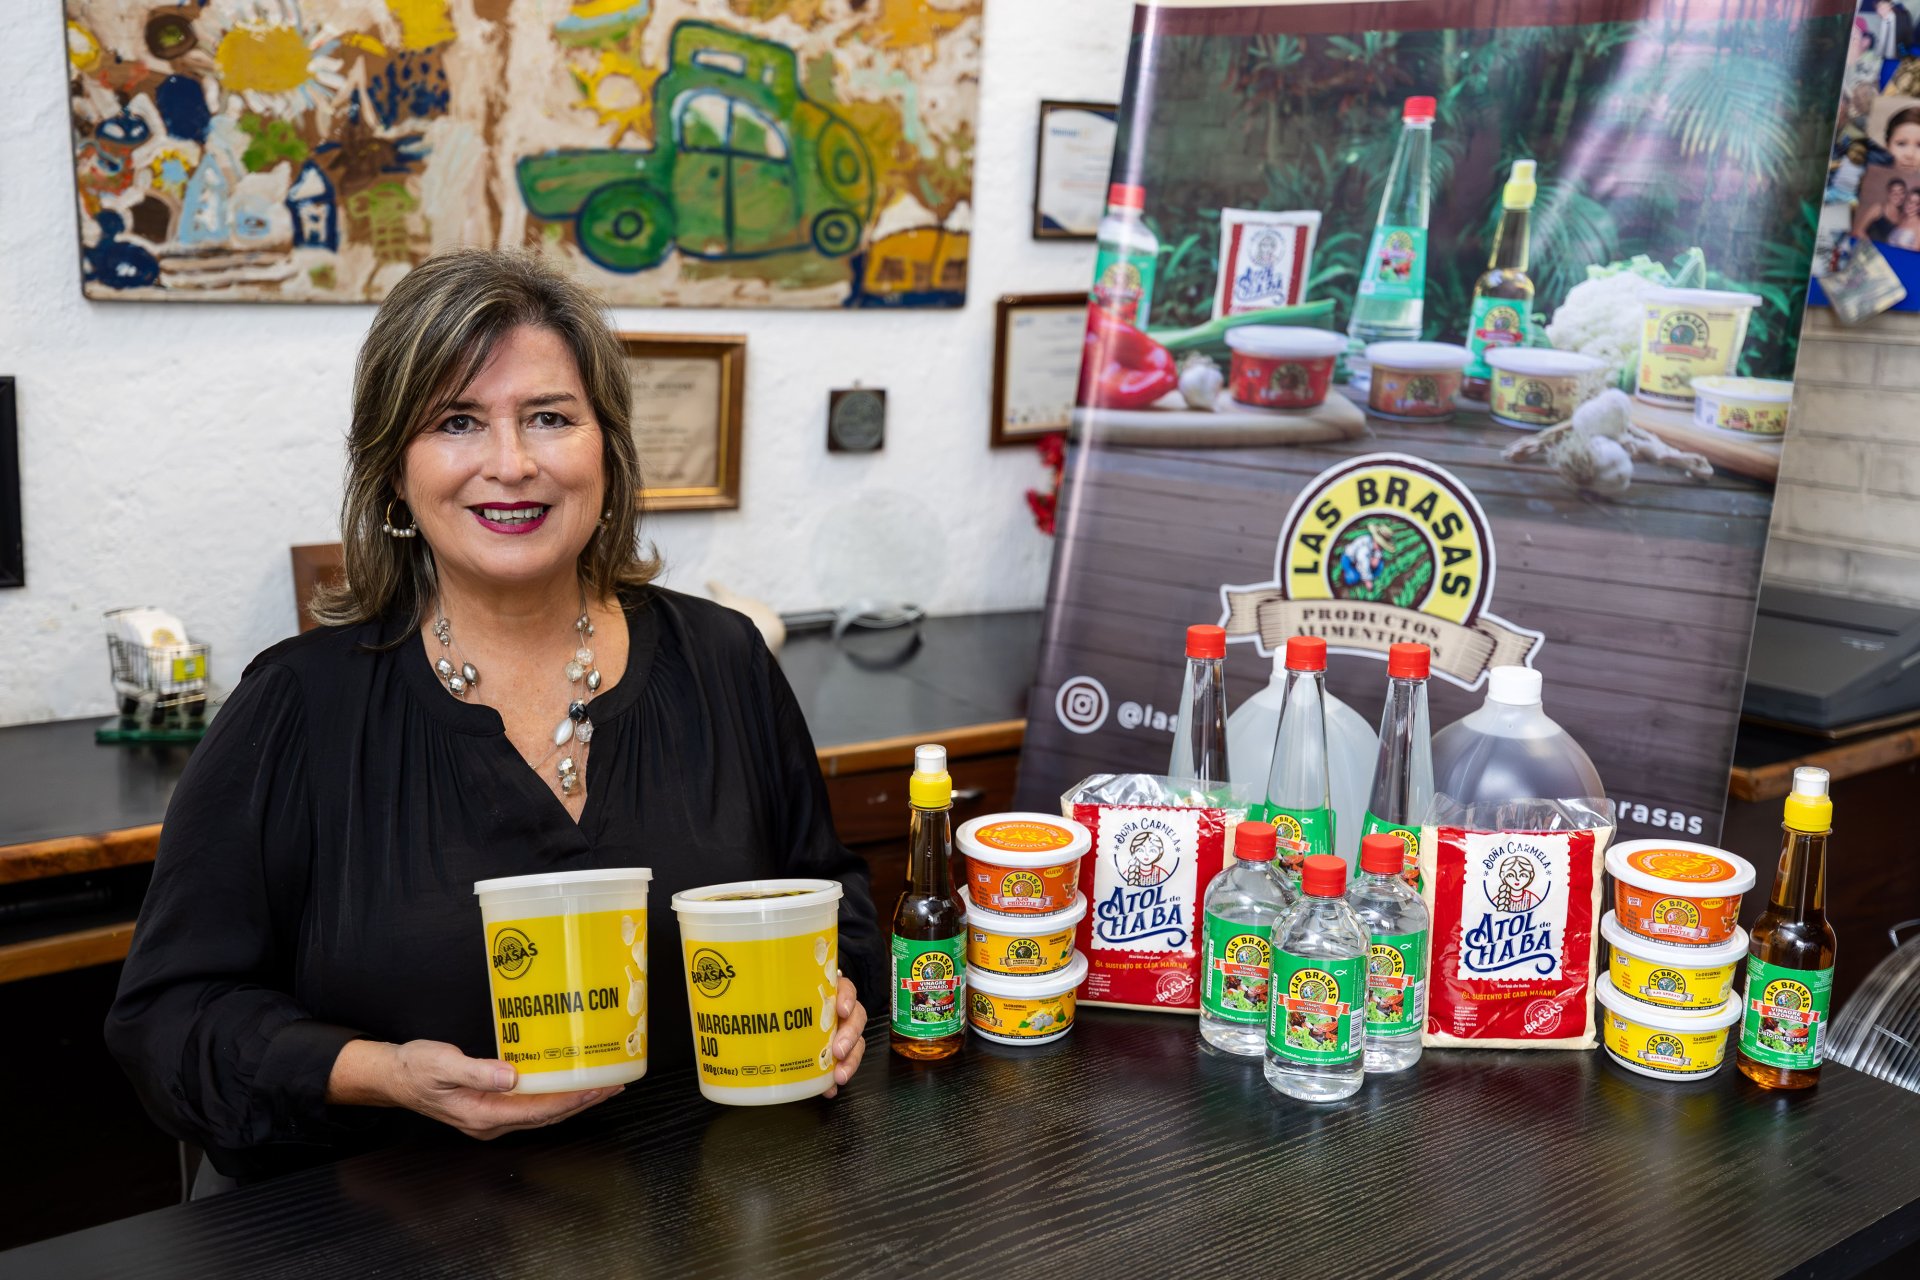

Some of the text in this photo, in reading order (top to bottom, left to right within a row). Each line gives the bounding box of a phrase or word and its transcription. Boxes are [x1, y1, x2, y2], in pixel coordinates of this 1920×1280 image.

[1294, 476, 1472, 598] LAS BRASAS
[1302, 608, 1442, 639] PRODUCTOS
[977, 829, 1069, 845] BRASAS
[1114, 818, 1181, 846] DOÑA CARMELA
[1280, 816, 1300, 838] BRASAS
[1395, 831, 1417, 853] BRASAS
[1482, 842, 1552, 869] DOÑA CARMELA
[1003, 873, 1041, 894] LAS BRASAS
[1098, 886, 1167, 920] ATOL
[1655, 903, 1667, 920] LAS
[1669, 900, 1697, 924] BRASAS
[1106, 904, 1183, 938] HABA
[1465, 912, 1537, 949] ATOL
[493, 942, 538, 969] BRASAS
[503, 943, 515, 953] LAS
[1009, 945, 1017, 956] LAS
[1018, 940, 1039, 956] BRASAS
[1228, 937, 1270, 963] LAS BRASAS
[1474, 930, 1552, 966] HABA
[702, 963, 714, 972] LAS
[914, 960, 924, 977] LAS
[926, 954, 952, 976] BRASAS
[1372, 947, 1402, 973] BRASAS
[691, 965, 736, 984] BRASAS
[1167, 980, 1177, 989] LAS
[1291, 971, 1336, 999] LAS BRASAS
[1651, 971, 1683, 991] LAS BRASAS
[1156, 974, 1194, 1002] BRASAS
[1766, 982, 1810, 1008] LAS BRASAS
[498, 987, 619, 1020] MARGARINA CON
[910, 1005, 925, 1013] Listo
[1535, 1008, 1545, 1018] LAS
[1771, 1007, 1802, 1016] VINAGRE
[697, 1007, 813, 1035] MARGARINA CON
[1524, 1002, 1563, 1034] BRASAS
[1768, 1012, 1803, 1022] SAZONADO
[502, 1022, 520, 1044] AJO
[701, 1036, 719, 1058] AJO
[1649, 1036, 1681, 1055] LAS BRASAS
